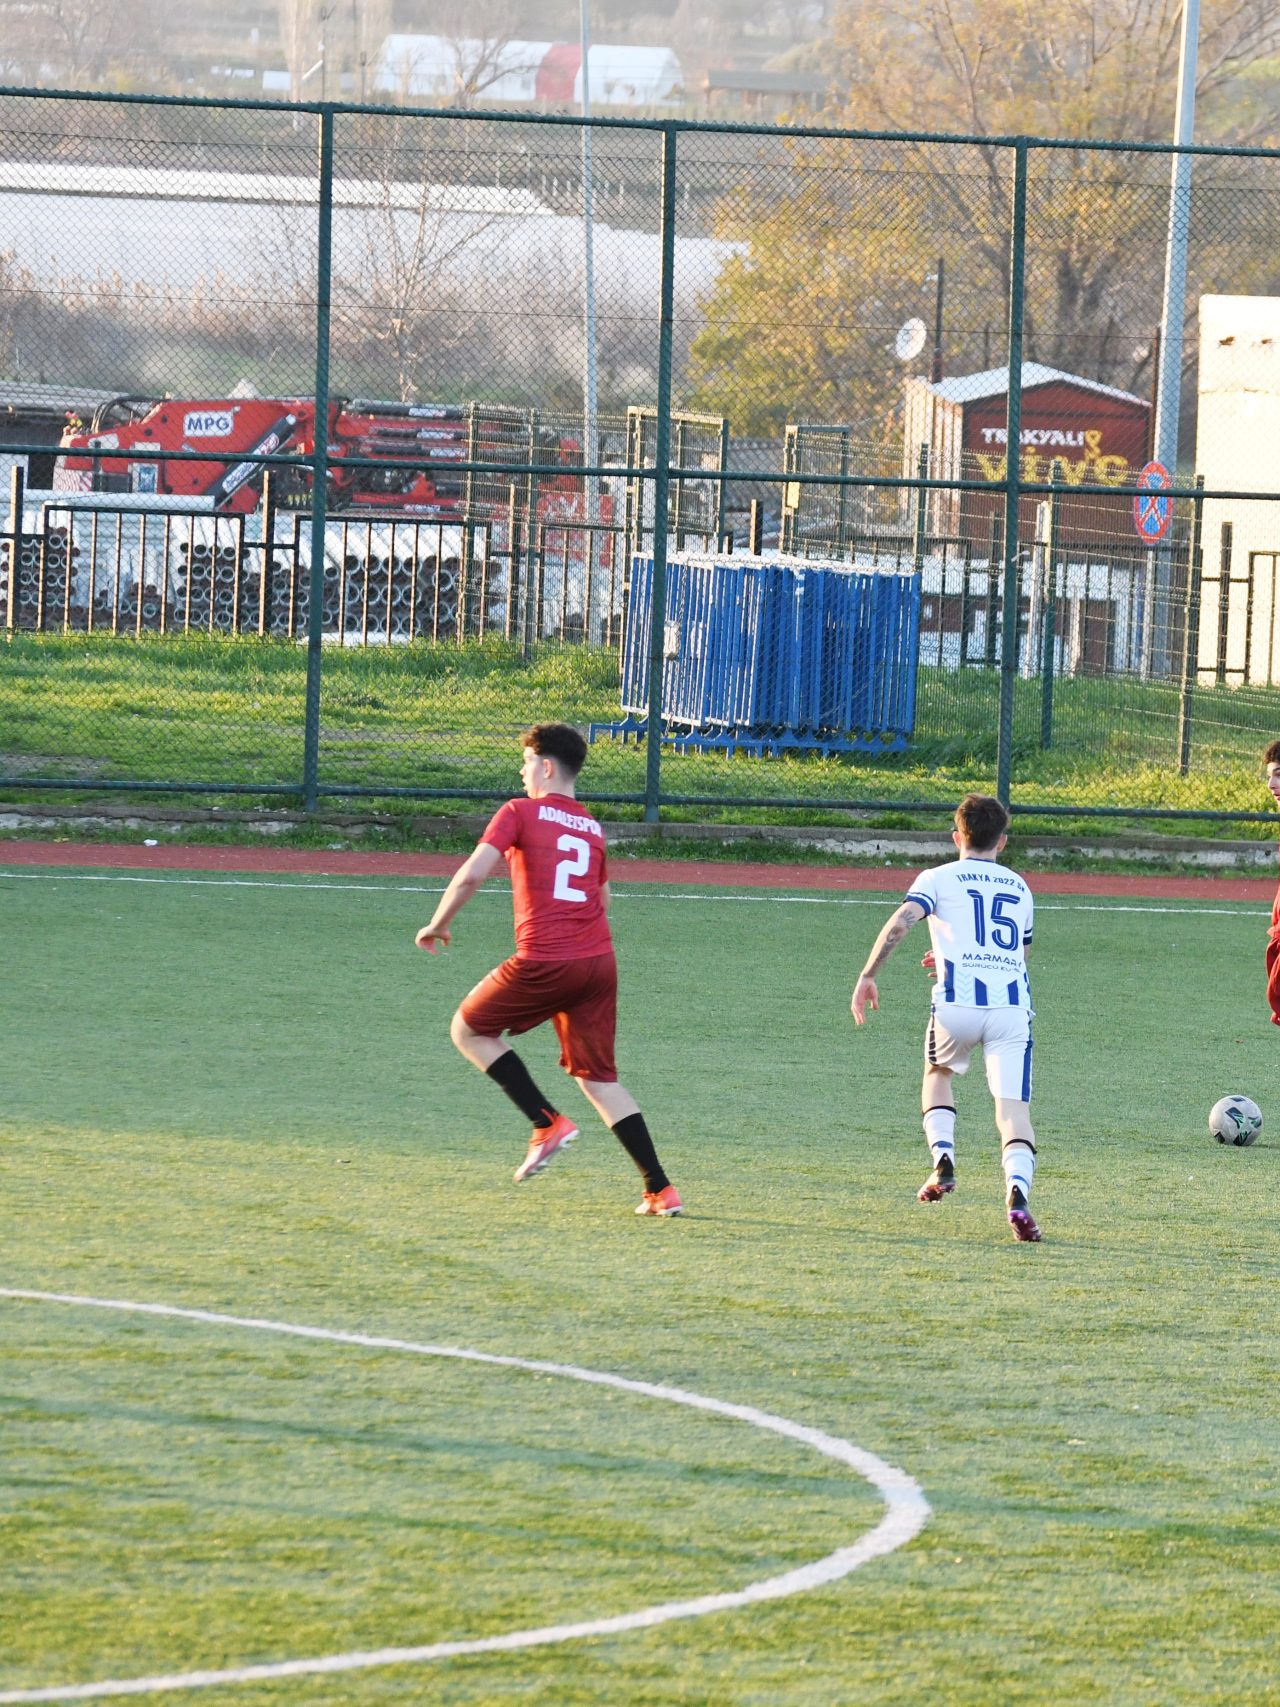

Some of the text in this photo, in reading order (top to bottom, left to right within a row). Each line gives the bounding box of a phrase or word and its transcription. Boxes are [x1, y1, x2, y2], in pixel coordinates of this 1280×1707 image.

[187, 417, 230, 431] MPG
[980, 428, 1085, 446] TRKYALI
[553, 833, 591, 903] 2
[956, 873, 990, 883] TRAKYA
[993, 876, 1015, 886] 2022
[966, 888, 1021, 952] 15
